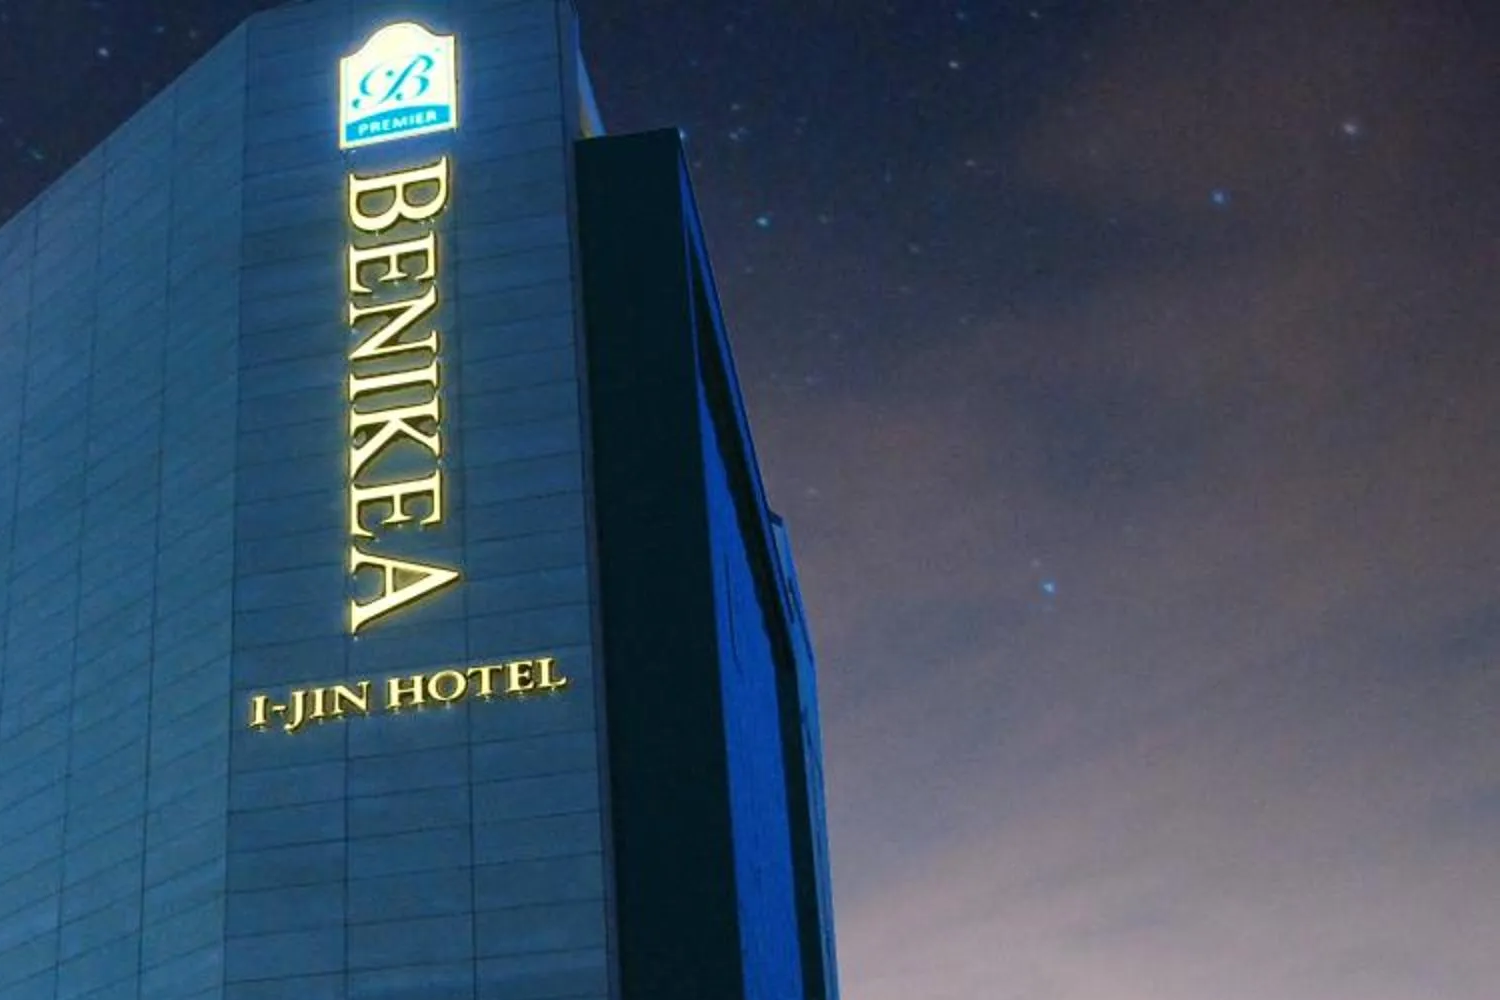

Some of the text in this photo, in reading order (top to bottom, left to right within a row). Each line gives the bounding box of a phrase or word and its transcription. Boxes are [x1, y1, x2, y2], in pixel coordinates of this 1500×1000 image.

[357, 109, 438, 137] PREMIER
[348, 155, 461, 635] BENIKEA
[250, 657, 568, 731] I-JIN HOTEL
